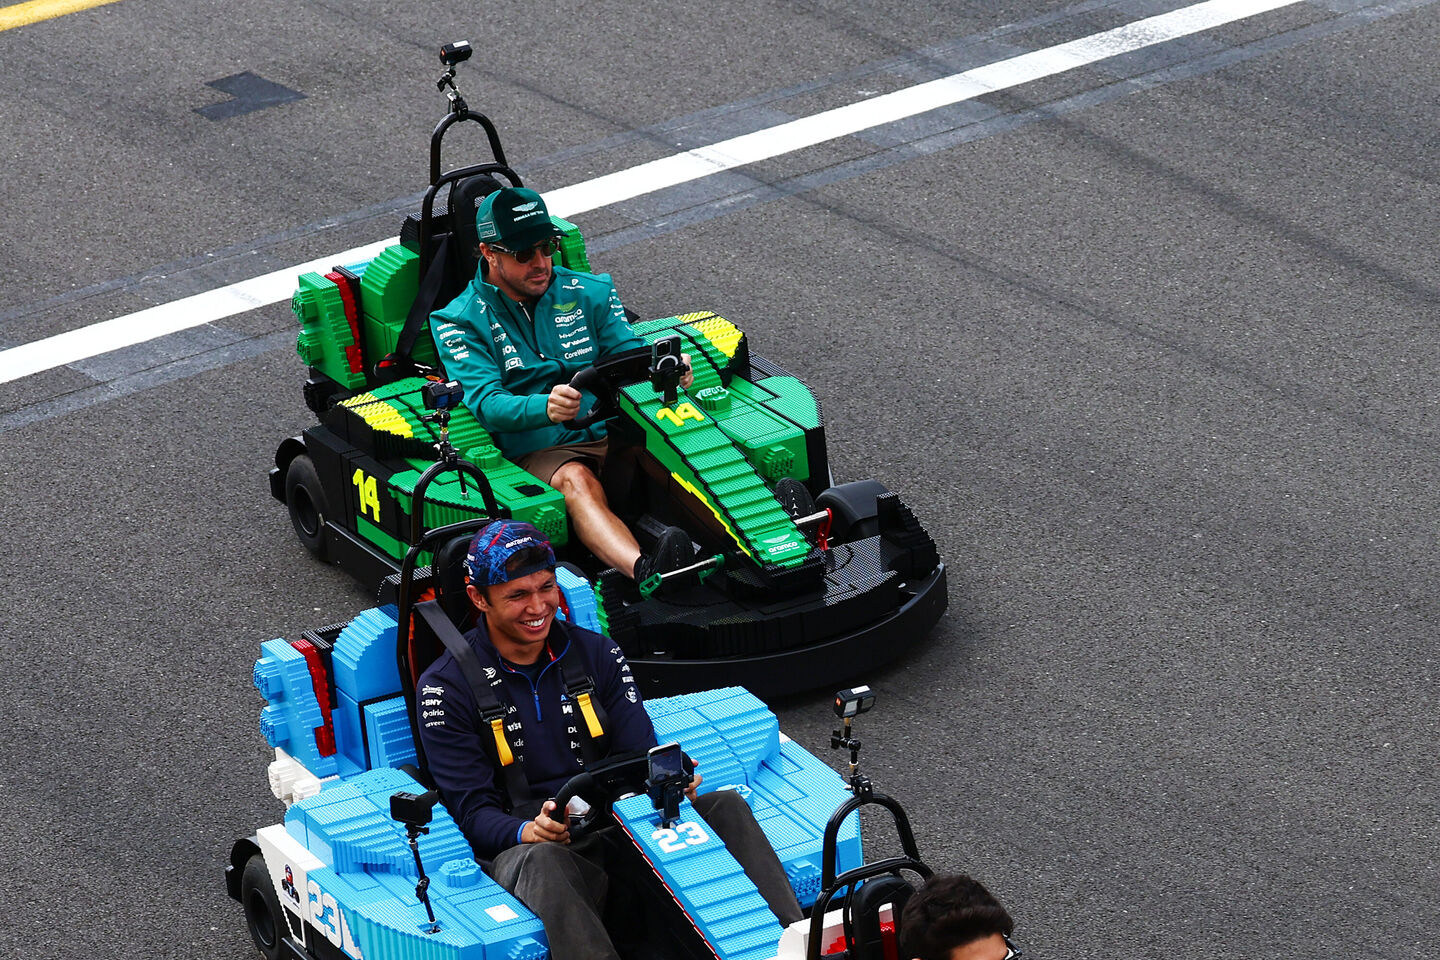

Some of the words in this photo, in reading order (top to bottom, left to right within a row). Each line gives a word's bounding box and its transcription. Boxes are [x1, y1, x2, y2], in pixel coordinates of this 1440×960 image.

[554, 308, 583, 324] aramco
[564, 346, 593, 360] CoreWeave
[656, 402, 705, 427] 14
[352, 468, 380, 523] 14
[768, 541, 798, 553] aramco
[651, 821, 710, 854] 23
[307, 880, 342, 949] 23
